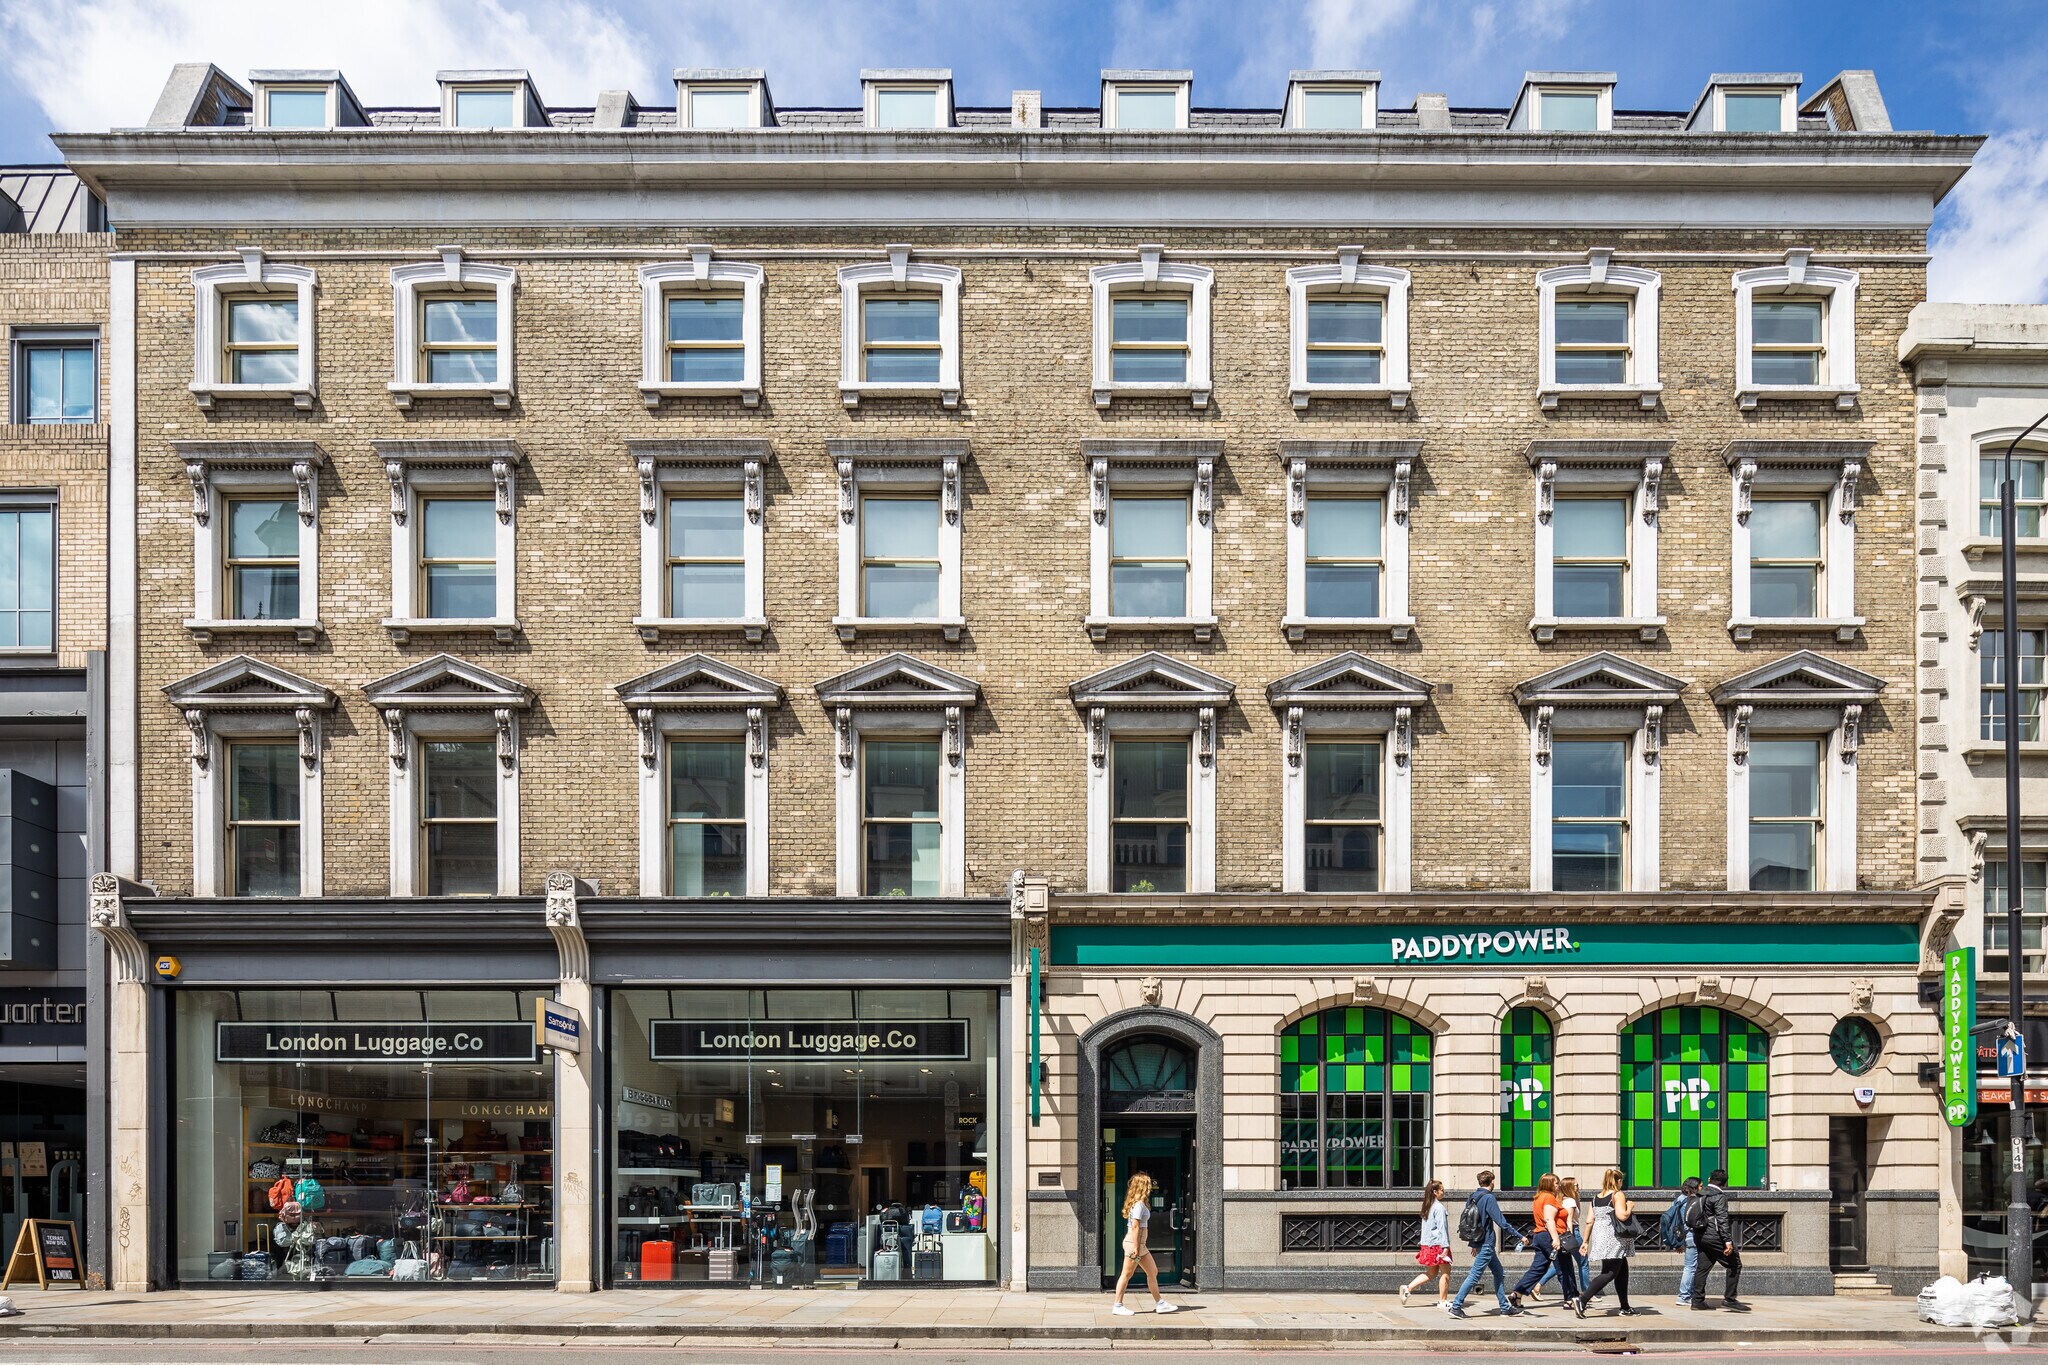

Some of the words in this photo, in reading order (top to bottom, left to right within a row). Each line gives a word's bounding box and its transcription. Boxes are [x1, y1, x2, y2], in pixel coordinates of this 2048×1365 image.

[266, 1033, 347, 1050] London
[354, 1033, 483, 1055] Luggage.Co
[700, 1032, 780, 1048] London
[788, 1031, 917, 1053] Luggage.Co
[290, 1094, 367, 1112] LONGCHAMP
[1977, 1091, 2030, 1100] REAKFT
[461, 1105, 554, 1116] LONGCHAM
